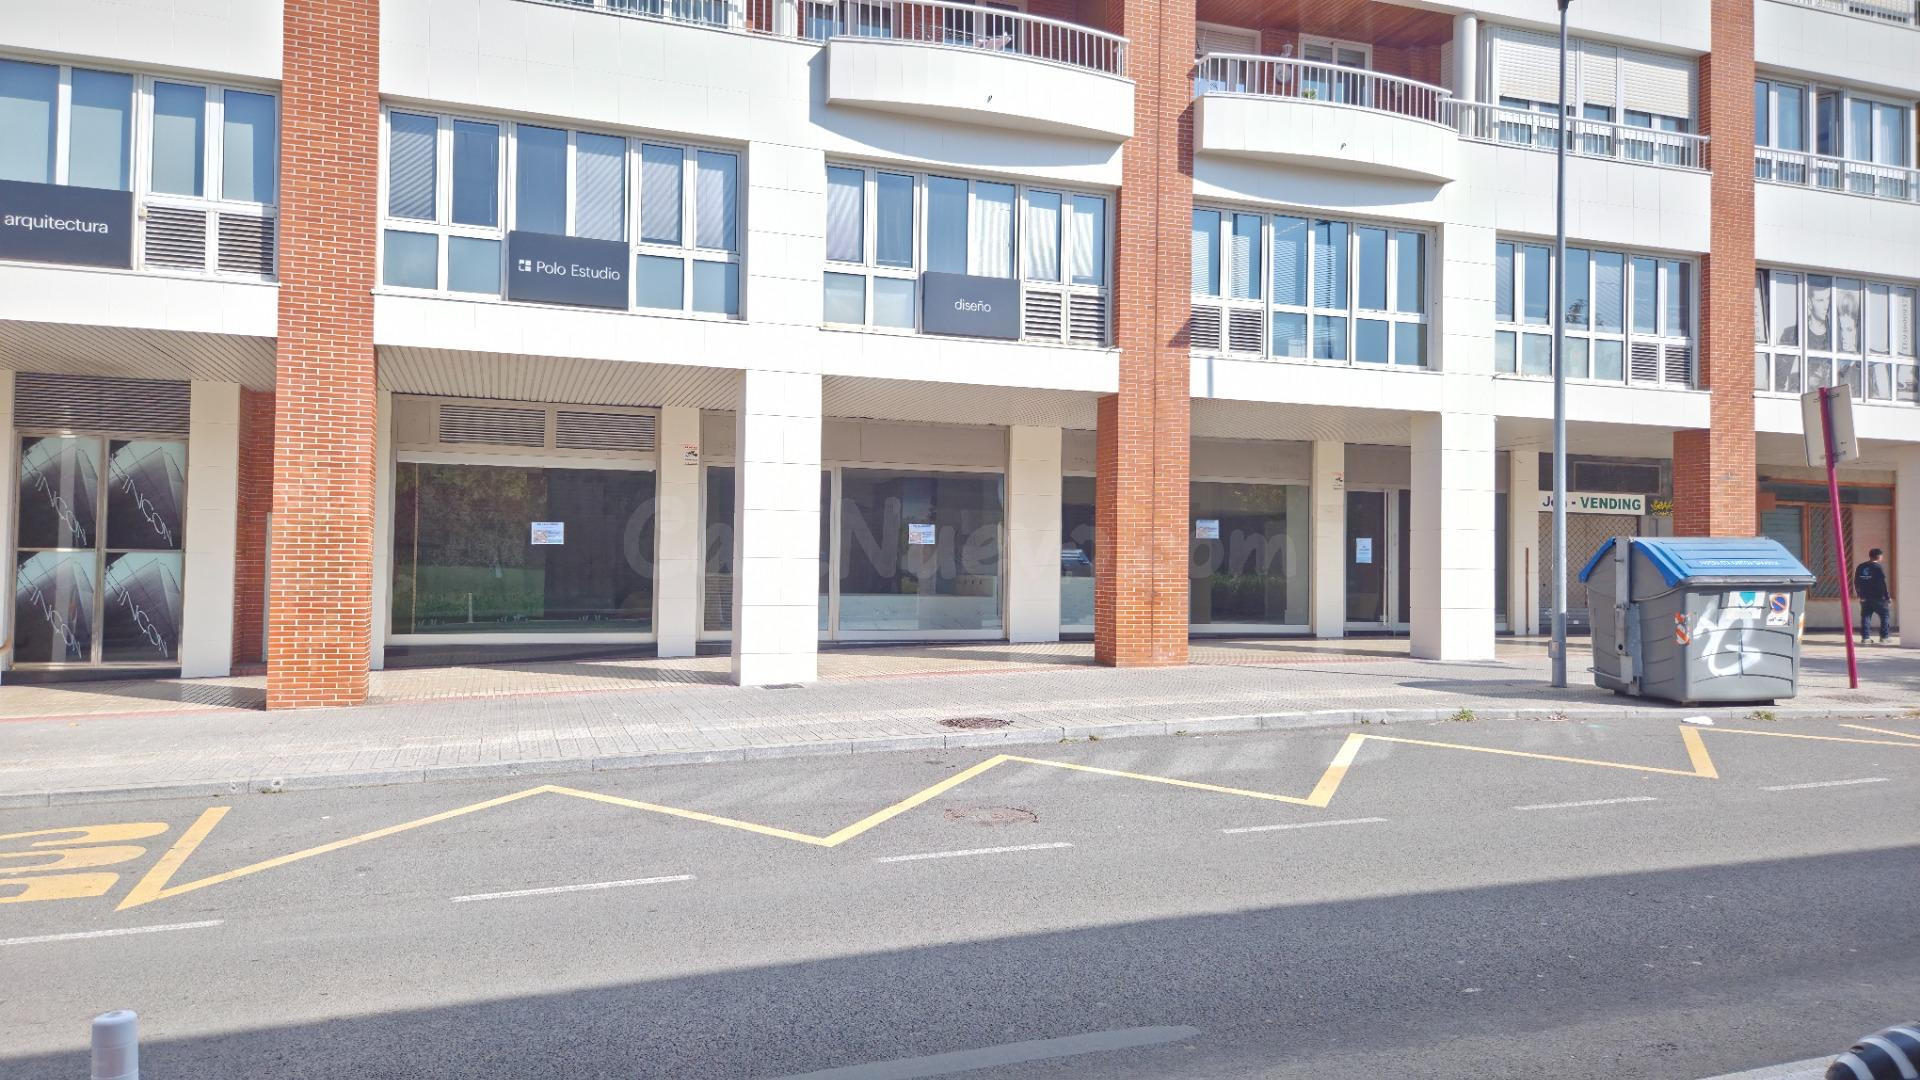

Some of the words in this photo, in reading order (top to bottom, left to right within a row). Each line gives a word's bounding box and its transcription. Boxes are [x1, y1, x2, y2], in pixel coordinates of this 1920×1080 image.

[4, 214, 109, 234] arquitectura
[536, 260, 567, 276] Polo
[571, 264, 621, 281] Estudio
[954, 298, 992, 313] diseño
[1580, 496, 1642, 511] VENDING
